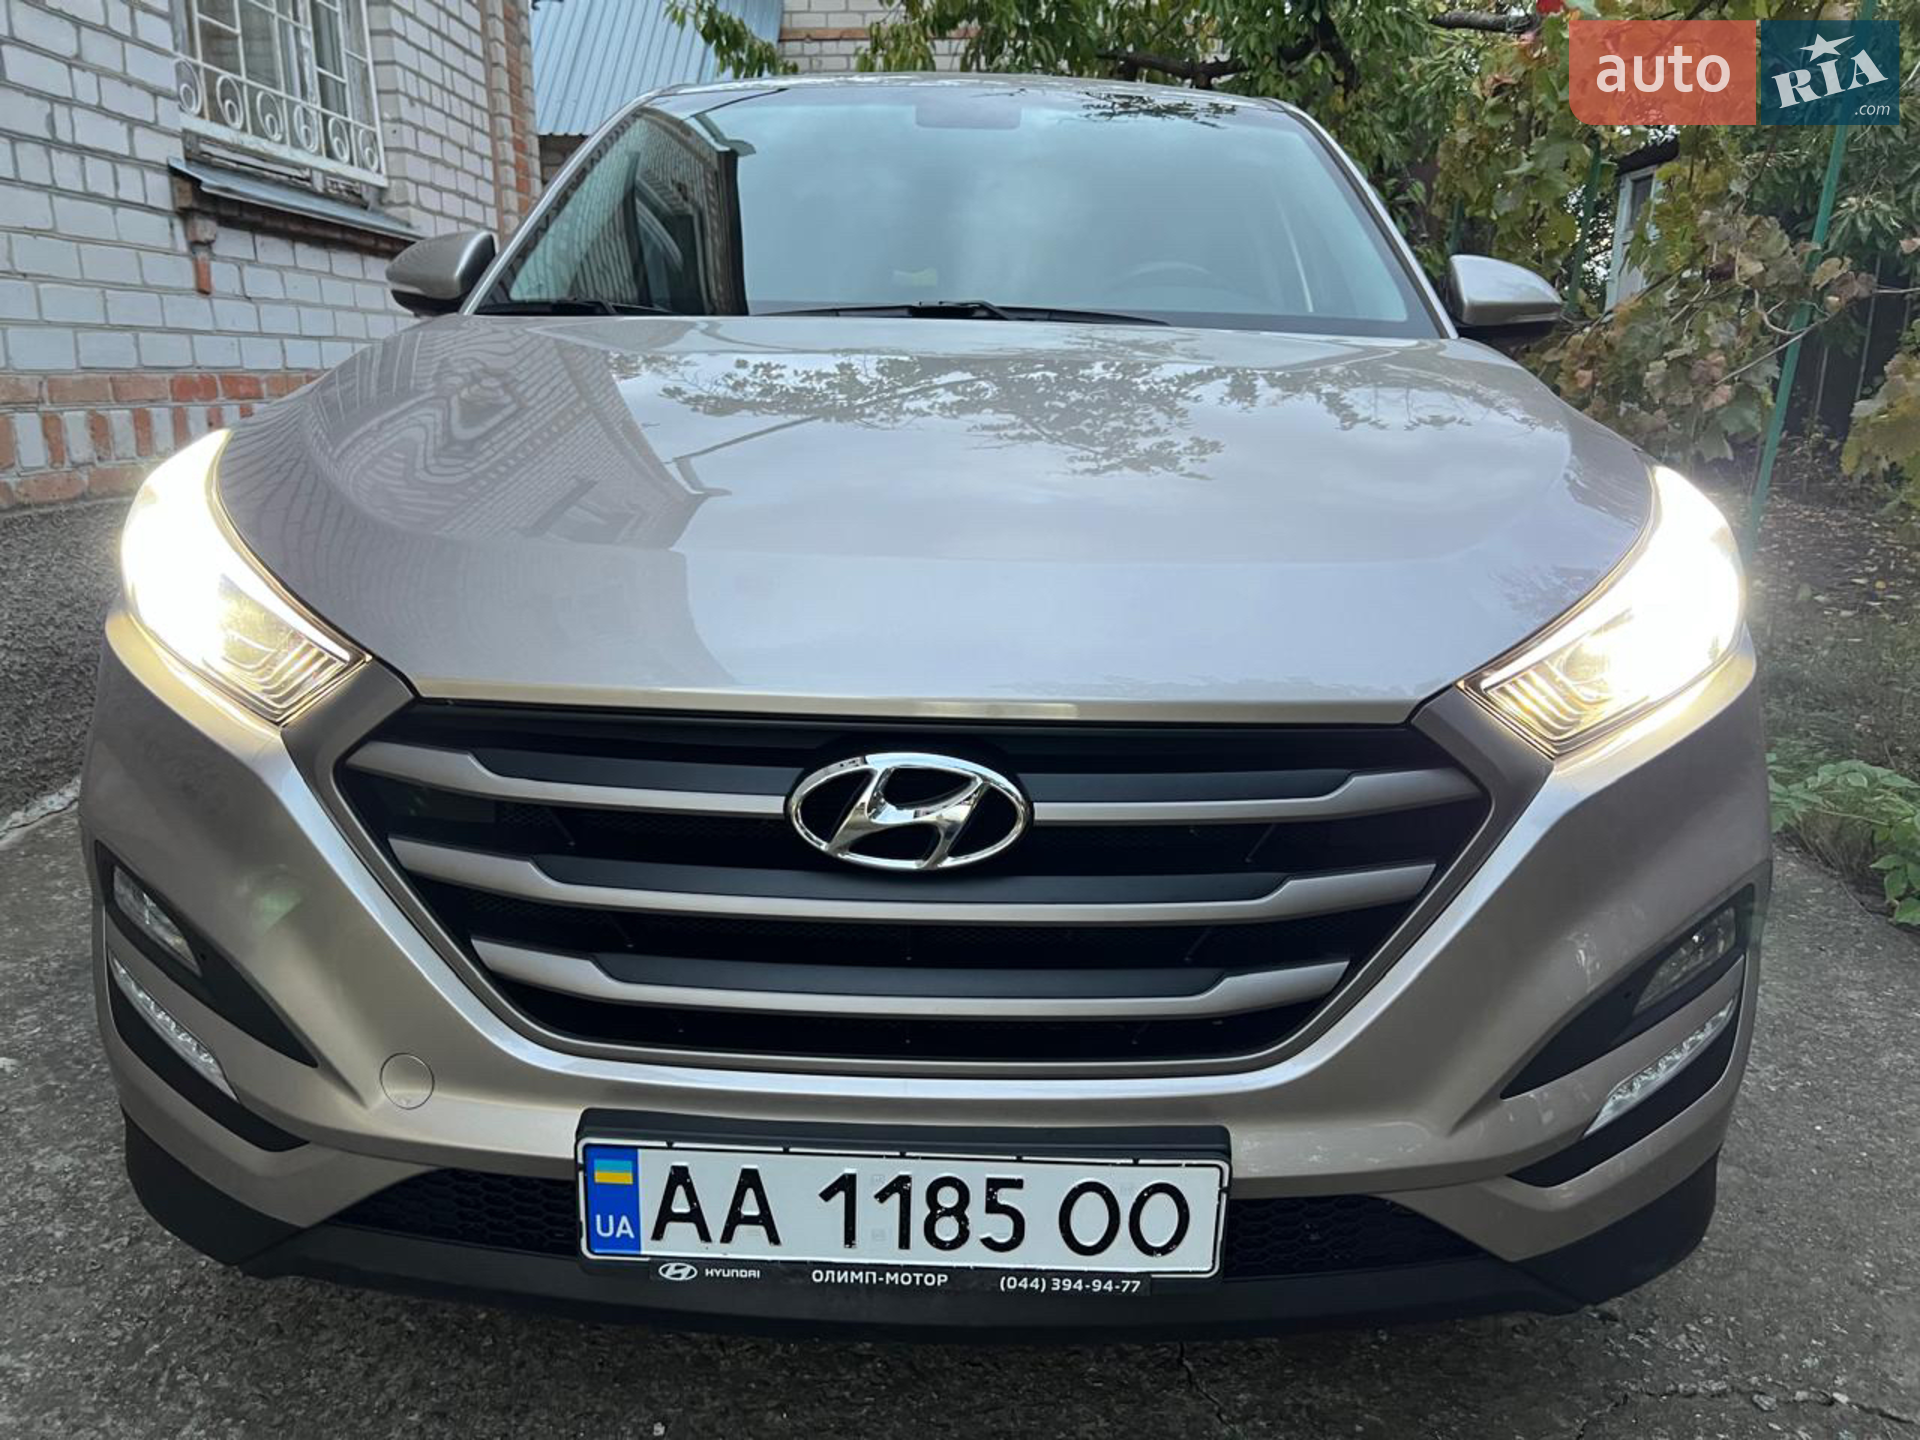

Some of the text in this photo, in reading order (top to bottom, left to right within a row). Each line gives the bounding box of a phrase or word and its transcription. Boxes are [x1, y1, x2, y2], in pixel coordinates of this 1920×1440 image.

[651, 1165, 782, 1247] AA
[818, 1167, 1026, 1254] 1185
[595, 1214, 635, 1241] UA
[704, 1267, 761, 1280] HYUNDAI
[811, 1269, 949, 1287] ОЛИМП-МОТОР
[999, 1275, 1142, 1293] (044) 394-94-77
